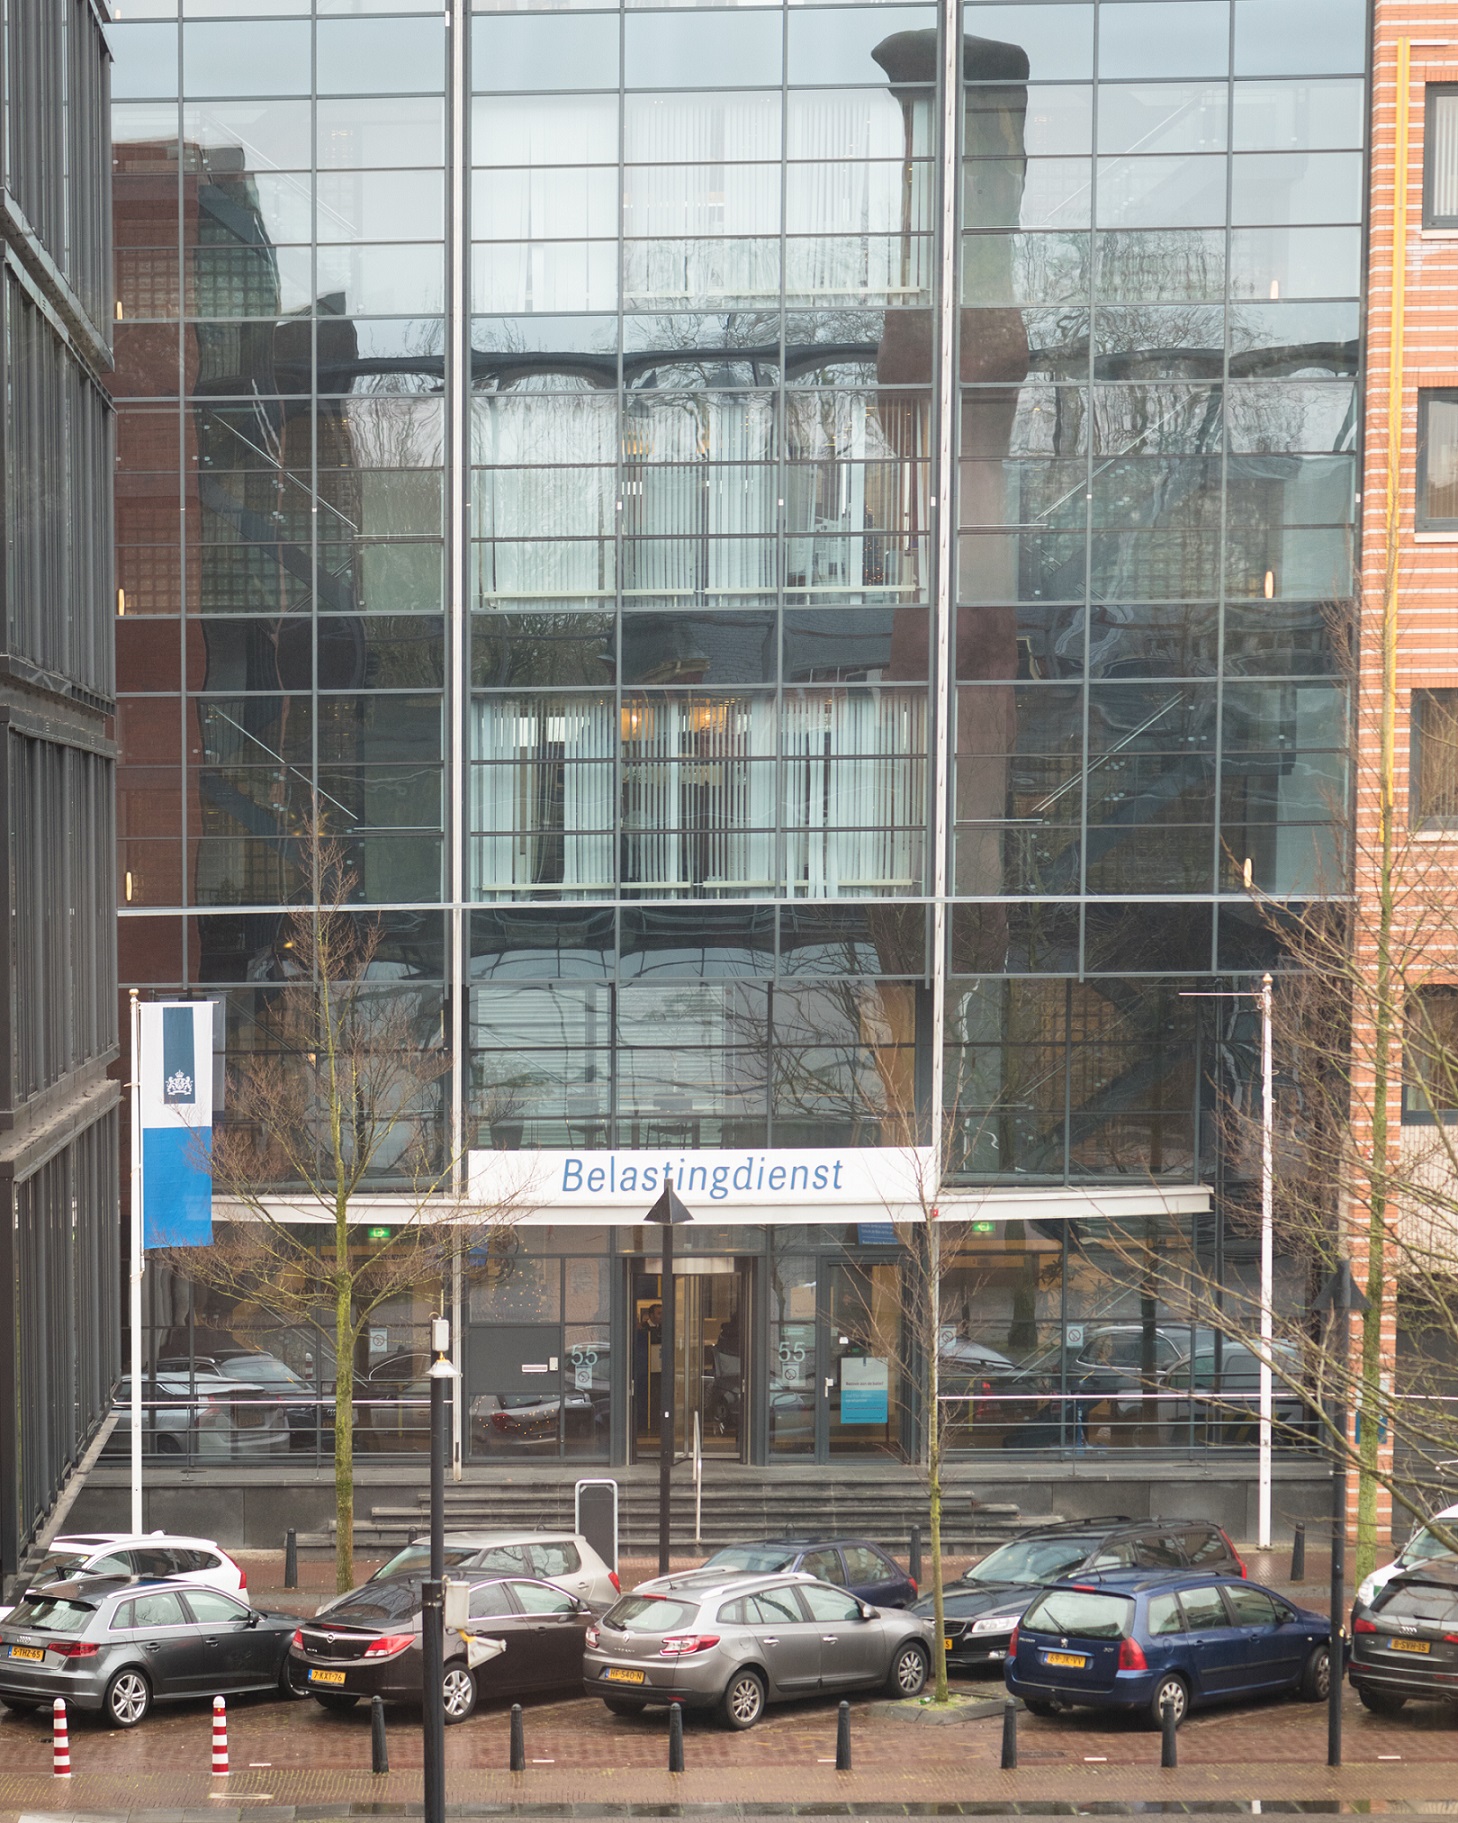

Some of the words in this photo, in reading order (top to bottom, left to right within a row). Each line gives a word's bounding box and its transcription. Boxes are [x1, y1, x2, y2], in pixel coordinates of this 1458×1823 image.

[562, 1156, 843, 1200] Belastingdienst
[571, 1344, 598, 1366] 55
[778, 1341, 806, 1362] 55
[313, 1671, 343, 1682] 7-KXT-76
